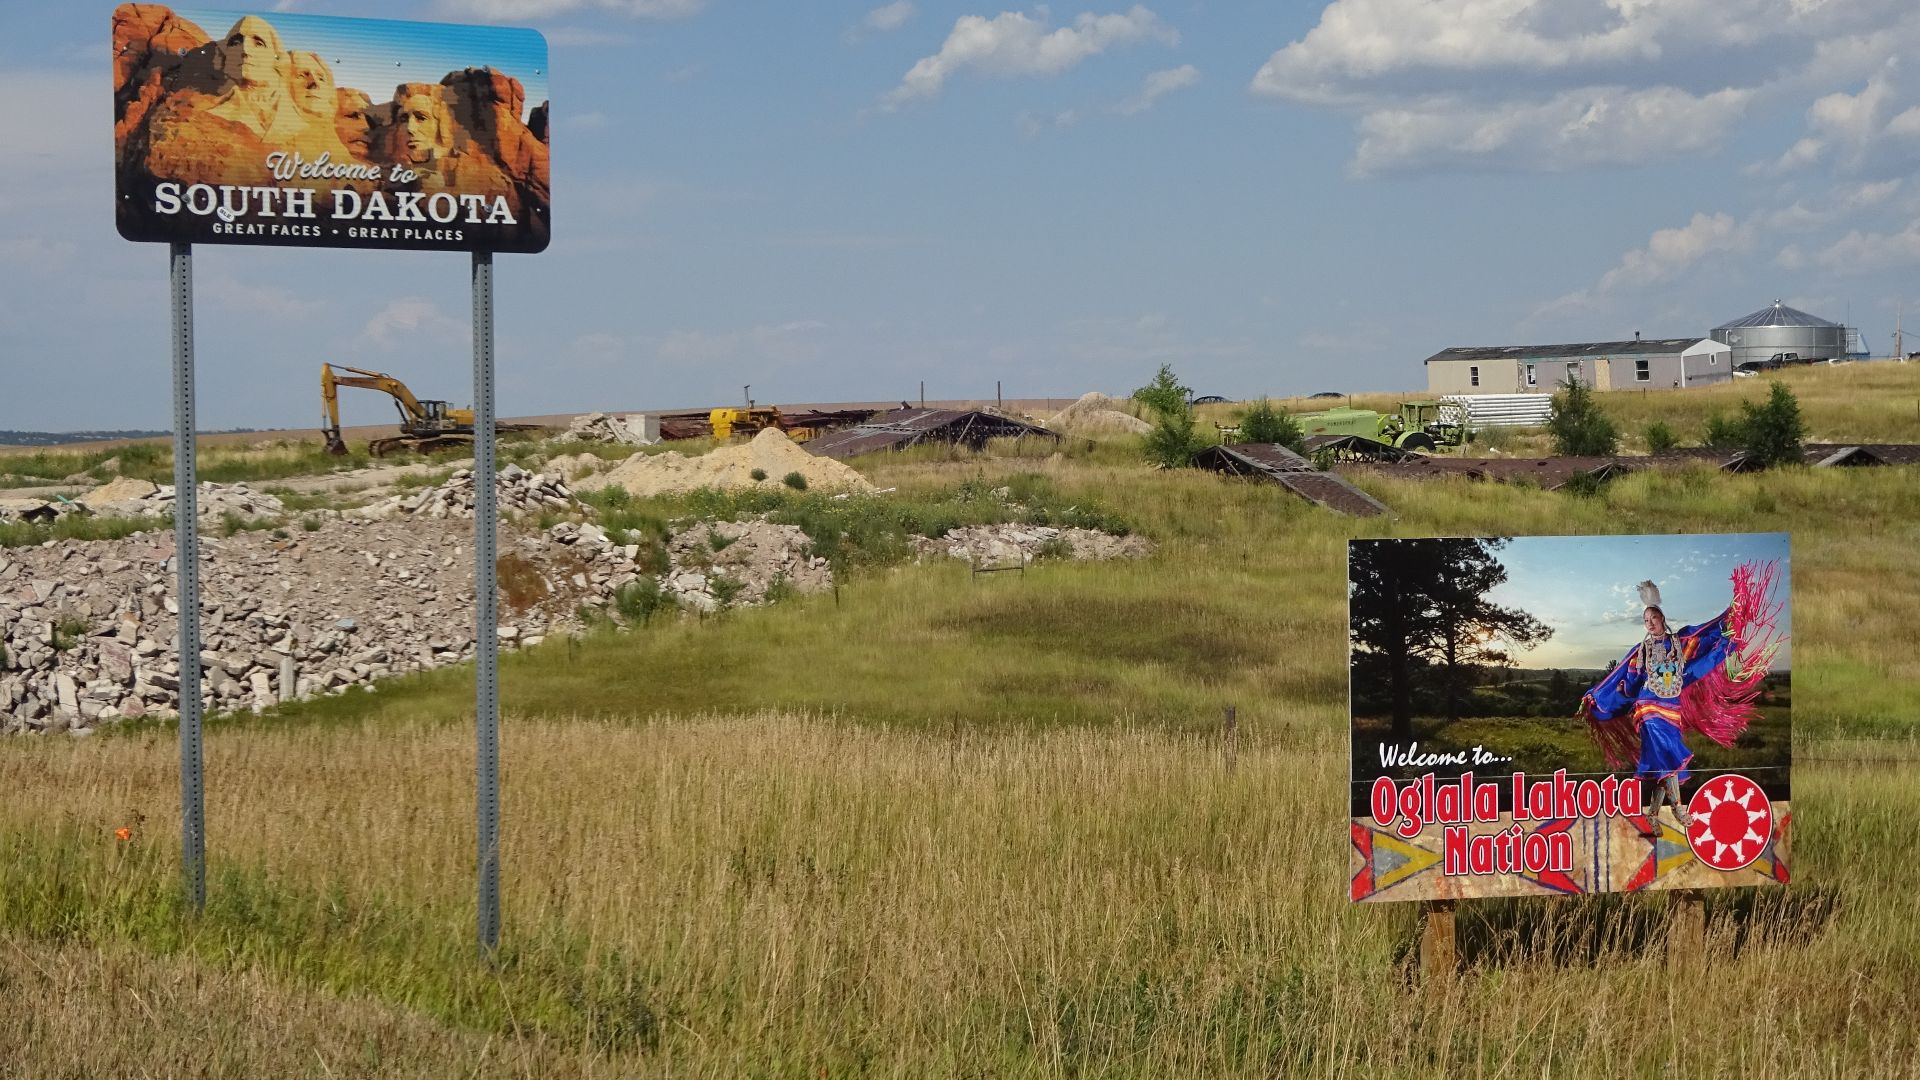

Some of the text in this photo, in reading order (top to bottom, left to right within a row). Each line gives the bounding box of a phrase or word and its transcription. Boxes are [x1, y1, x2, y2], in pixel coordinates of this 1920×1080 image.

[266, 151, 418, 184] Welcome to
[155, 182, 518, 225] SOUTH DAKOTA
[212, 223, 464, 241] GREAT FACES GREAT PLACES
[1379, 741, 1468, 768] Welcome
[1371, 768, 1642, 839] Oglala Lakota
[1444, 823, 1574, 876] Nation
